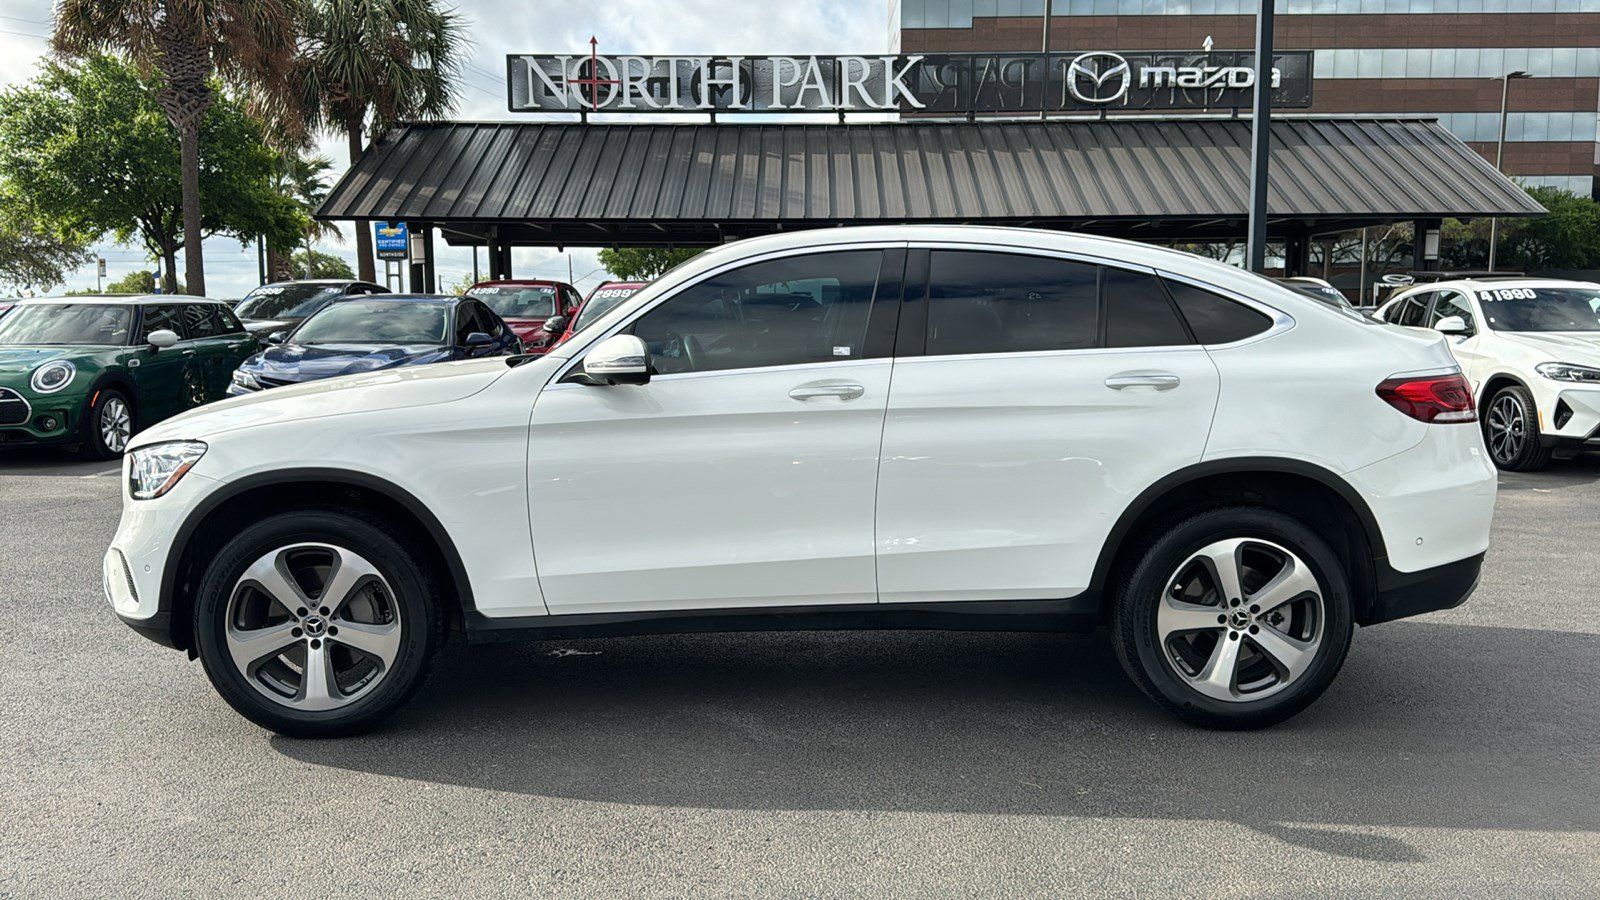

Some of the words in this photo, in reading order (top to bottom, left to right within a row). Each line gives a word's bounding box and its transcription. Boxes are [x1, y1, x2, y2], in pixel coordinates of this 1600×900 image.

[519, 55, 746, 109] NORTH
[767, 55, 926, 109] PARK
[1480, 288, 1537, 302] 41990
